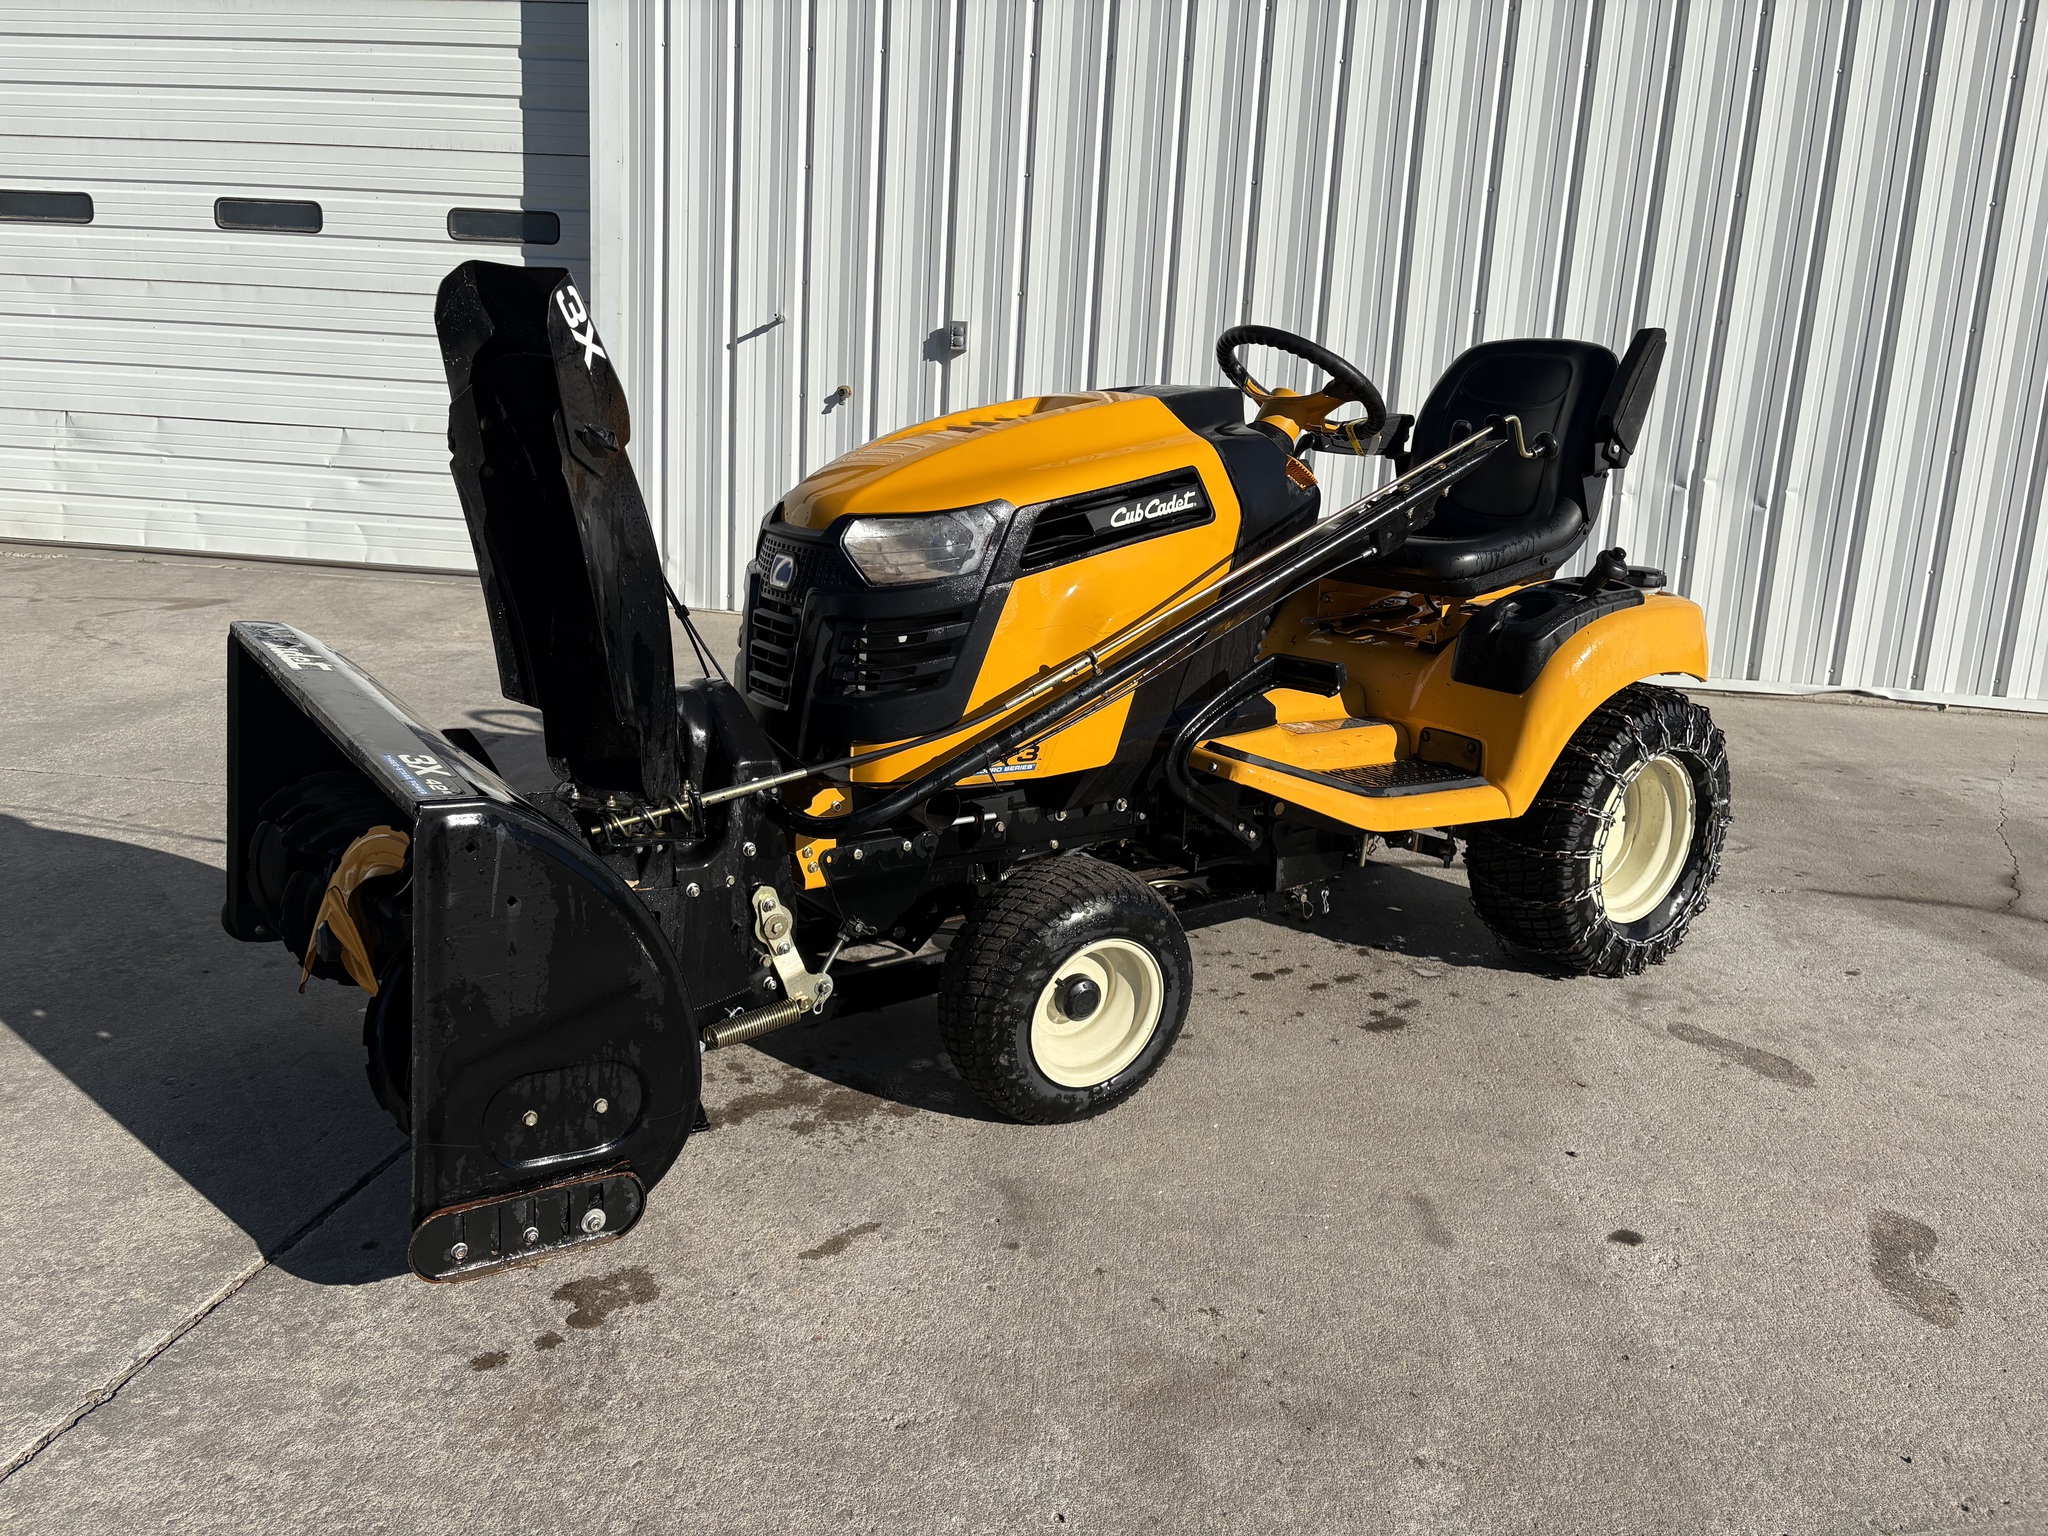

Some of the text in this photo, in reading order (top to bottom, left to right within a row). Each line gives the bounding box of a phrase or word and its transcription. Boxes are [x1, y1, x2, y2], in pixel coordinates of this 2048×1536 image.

[555, 285, 607, 371] 3X
[1110, 491, 1196, 527] Cub Cadet
[398, 754, 452, 776] 3X
[1004, 763, 1034, 772] SERIES
